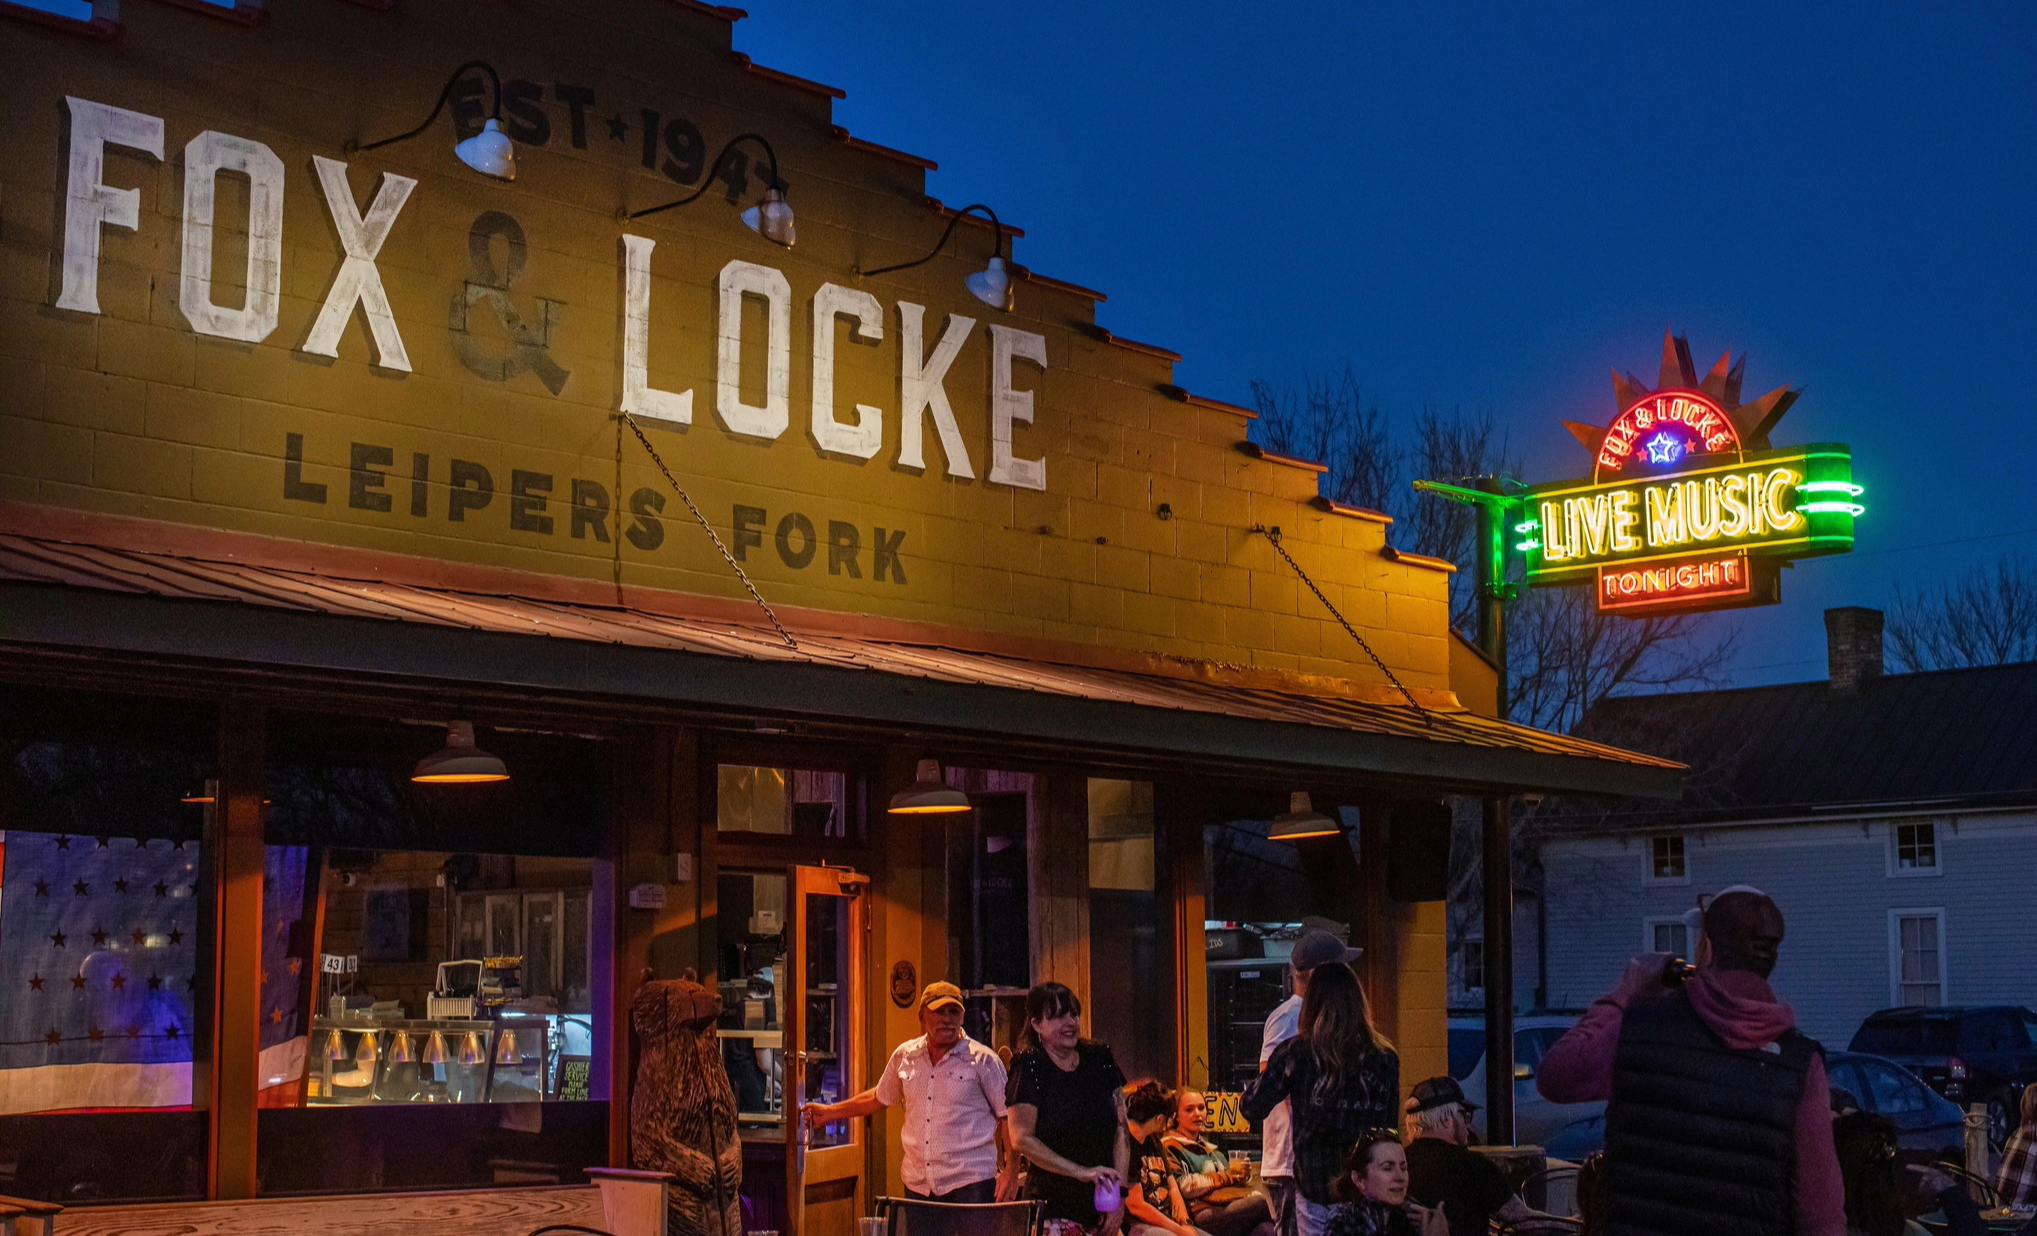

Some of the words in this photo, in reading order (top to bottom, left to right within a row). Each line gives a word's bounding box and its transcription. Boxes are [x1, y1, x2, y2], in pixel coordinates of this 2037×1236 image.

[446, 77, 595, 150] EST
[55, 96, 418, 373] FOX
[449, 210, 571, 396] &
[620, 233, 1048, 491] LOCKE
[1599, 419, 1634, 468] FOX
[1635, 407, 1654, 428] &
[1656, 398, 1727, 452] LOCKE
[283, 432, 666, 550] LEIPERS
[732, 503, 908, 585] FORK
[1541, 489, 1632, 562] LIVE
[1644, 467, 1798, 548] MUSIC
[1603, 559, 1739, 598] TONIGHT
[327, 958, 339, 971] 43
